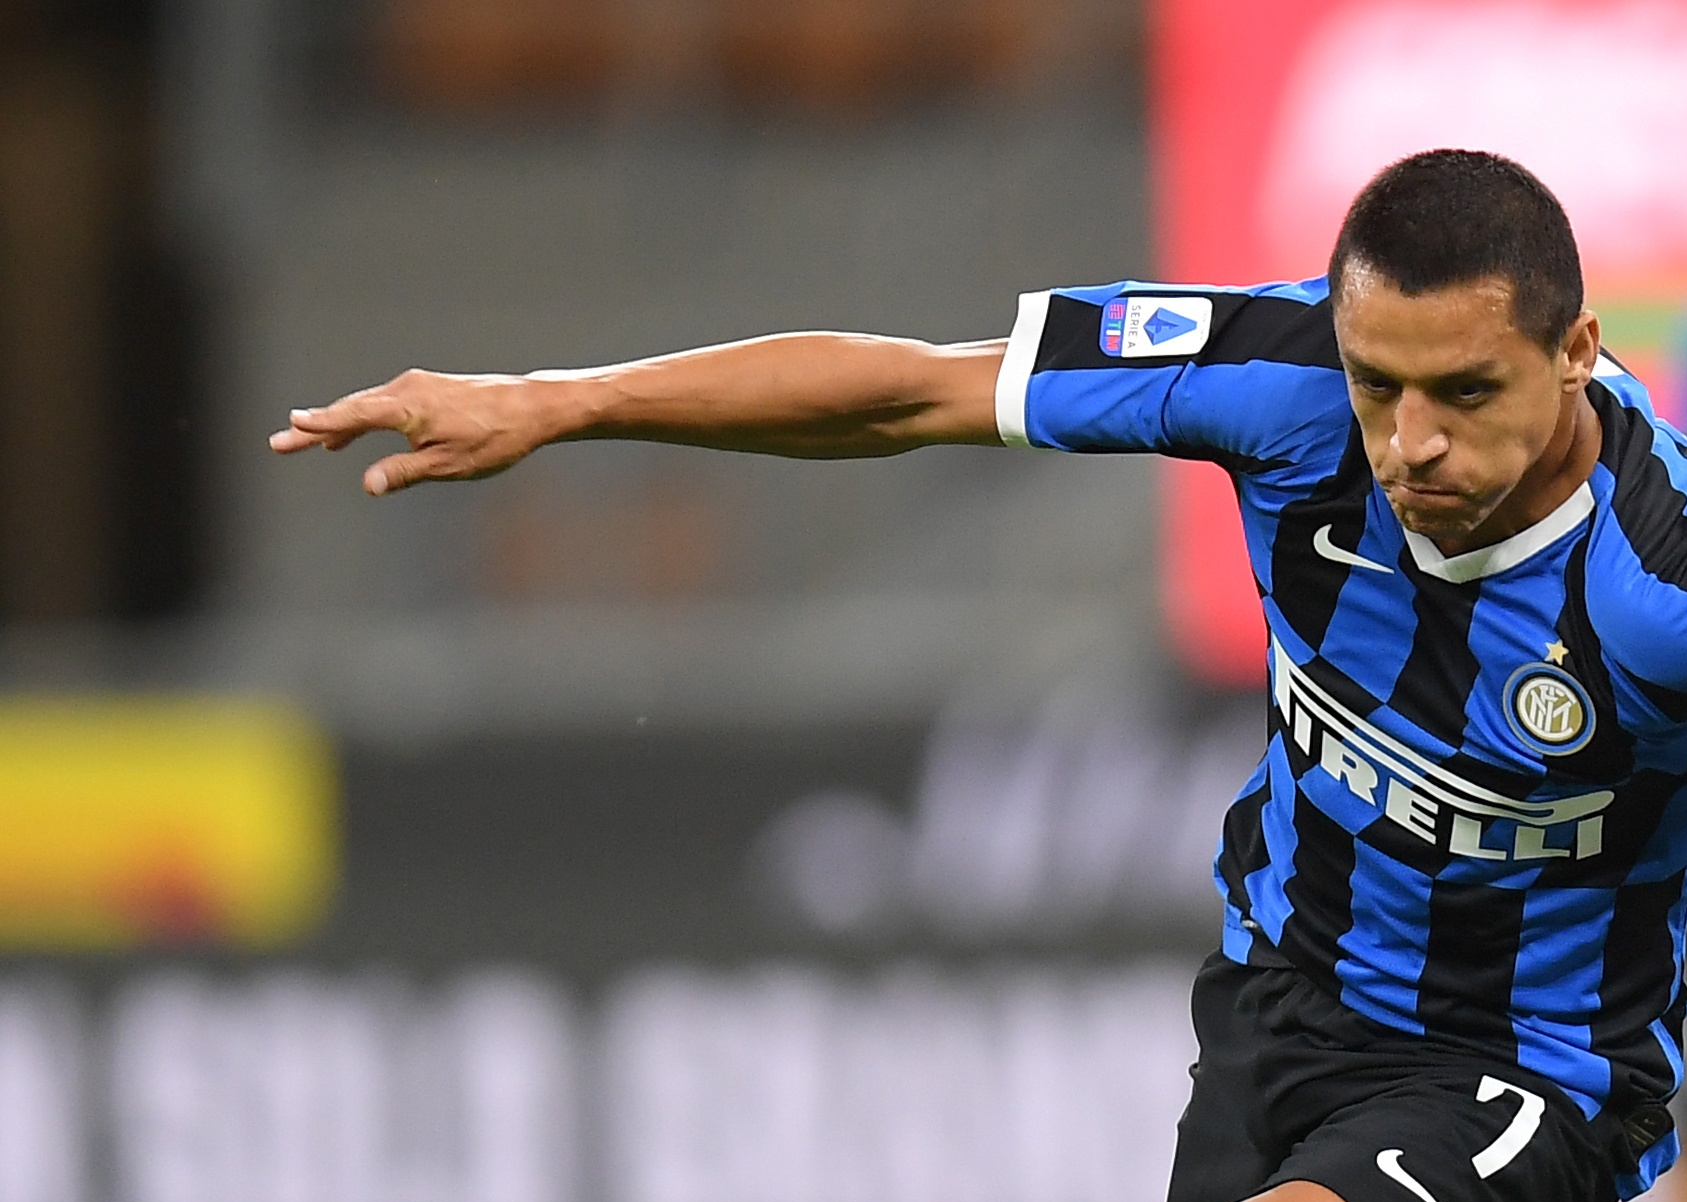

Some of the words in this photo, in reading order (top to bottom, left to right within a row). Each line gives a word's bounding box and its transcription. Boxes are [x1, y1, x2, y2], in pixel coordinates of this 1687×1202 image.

[1128, 305, 1141, 337] SERIE
[1127, 341, 1136, 349] A
[1471, 1074, 1546, 1179] 7
